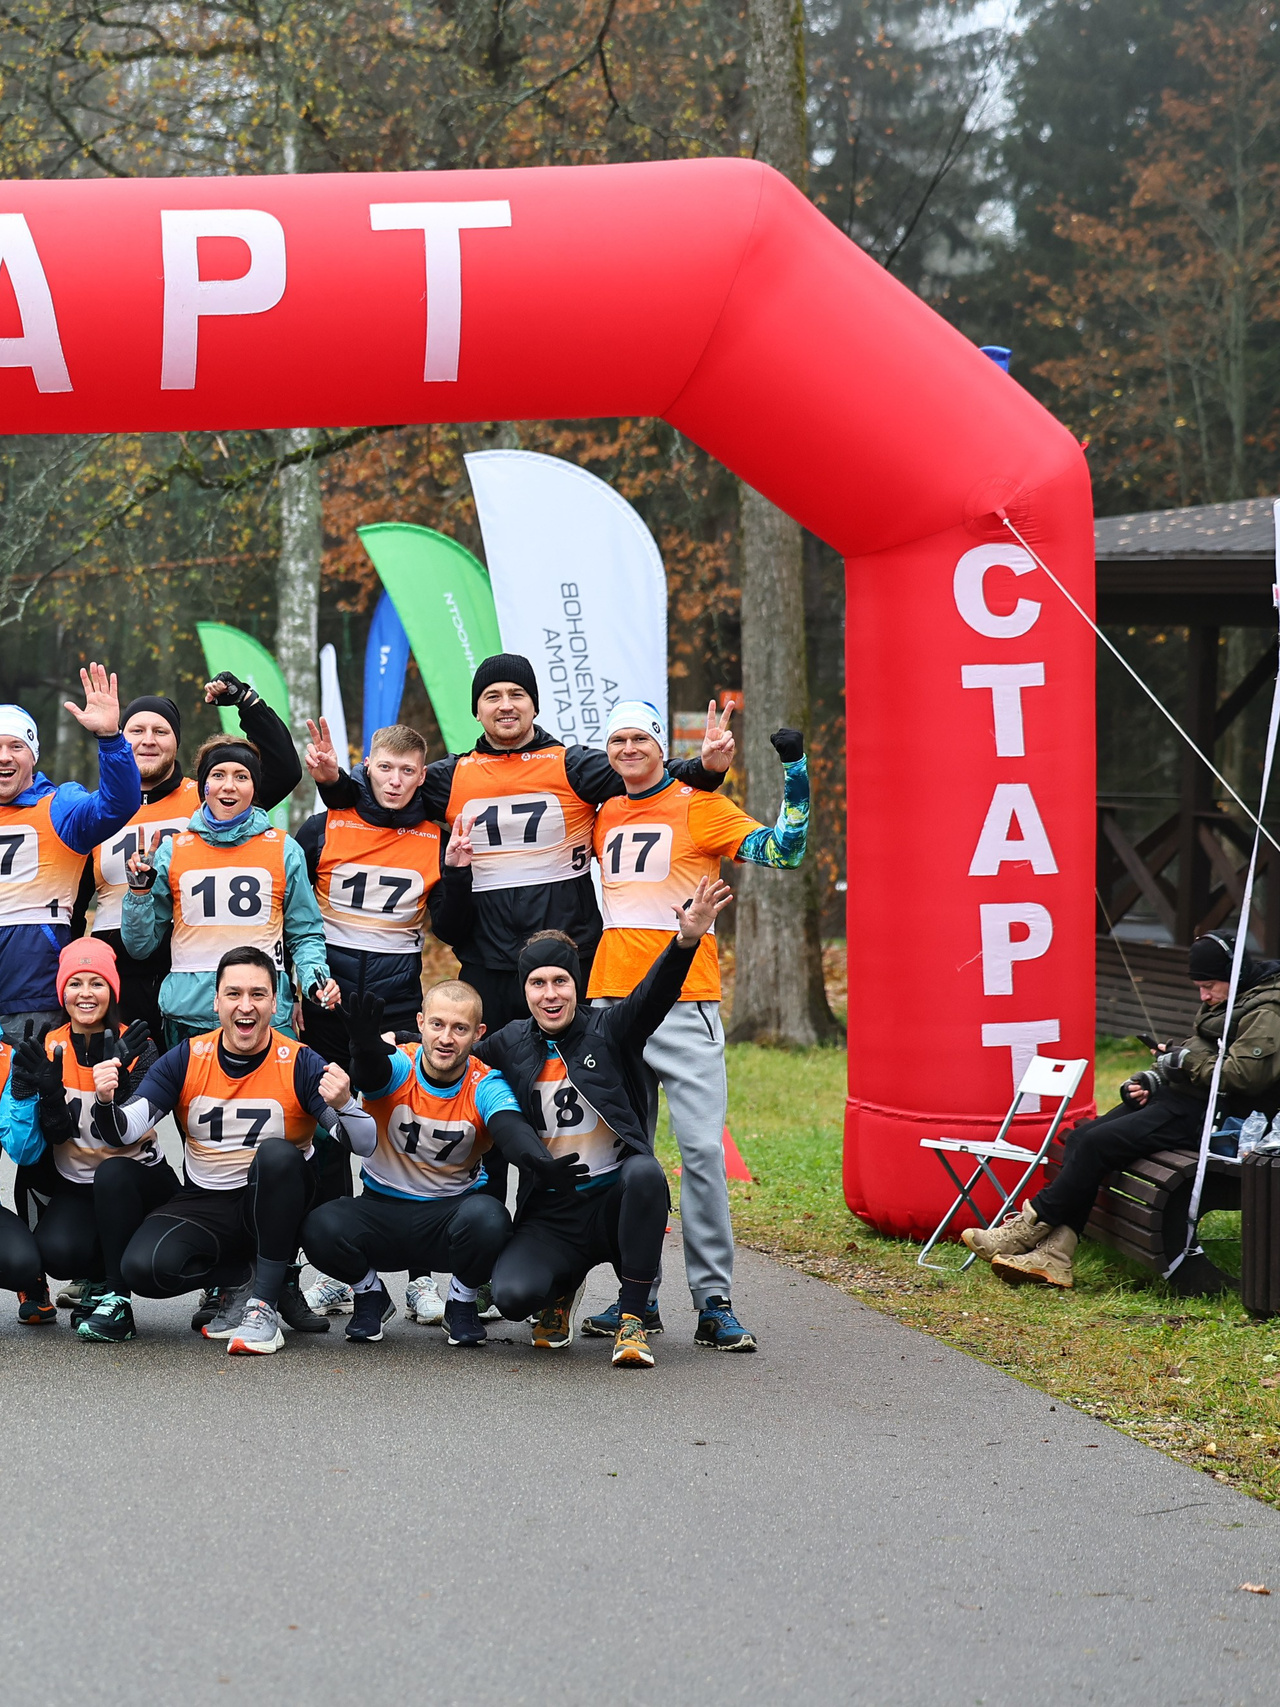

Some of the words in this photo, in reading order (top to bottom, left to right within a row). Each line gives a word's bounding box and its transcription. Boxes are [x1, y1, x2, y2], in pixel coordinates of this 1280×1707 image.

[474, 801, 547, 846] 17
[952, 543, 1060, 1114] СТАРТ
[112, 828, 181, 867] 1
[571, 845, 586, 871] 5
[606, 832, 662, 874] 17
[191, 875, 261, 917] 18
[341, 871, 412, 914] 17
[198, 1106, 272, 1148] 17
[532, 1087, 585, 1131] 18
[398, 1121, 465, 1162] 17
